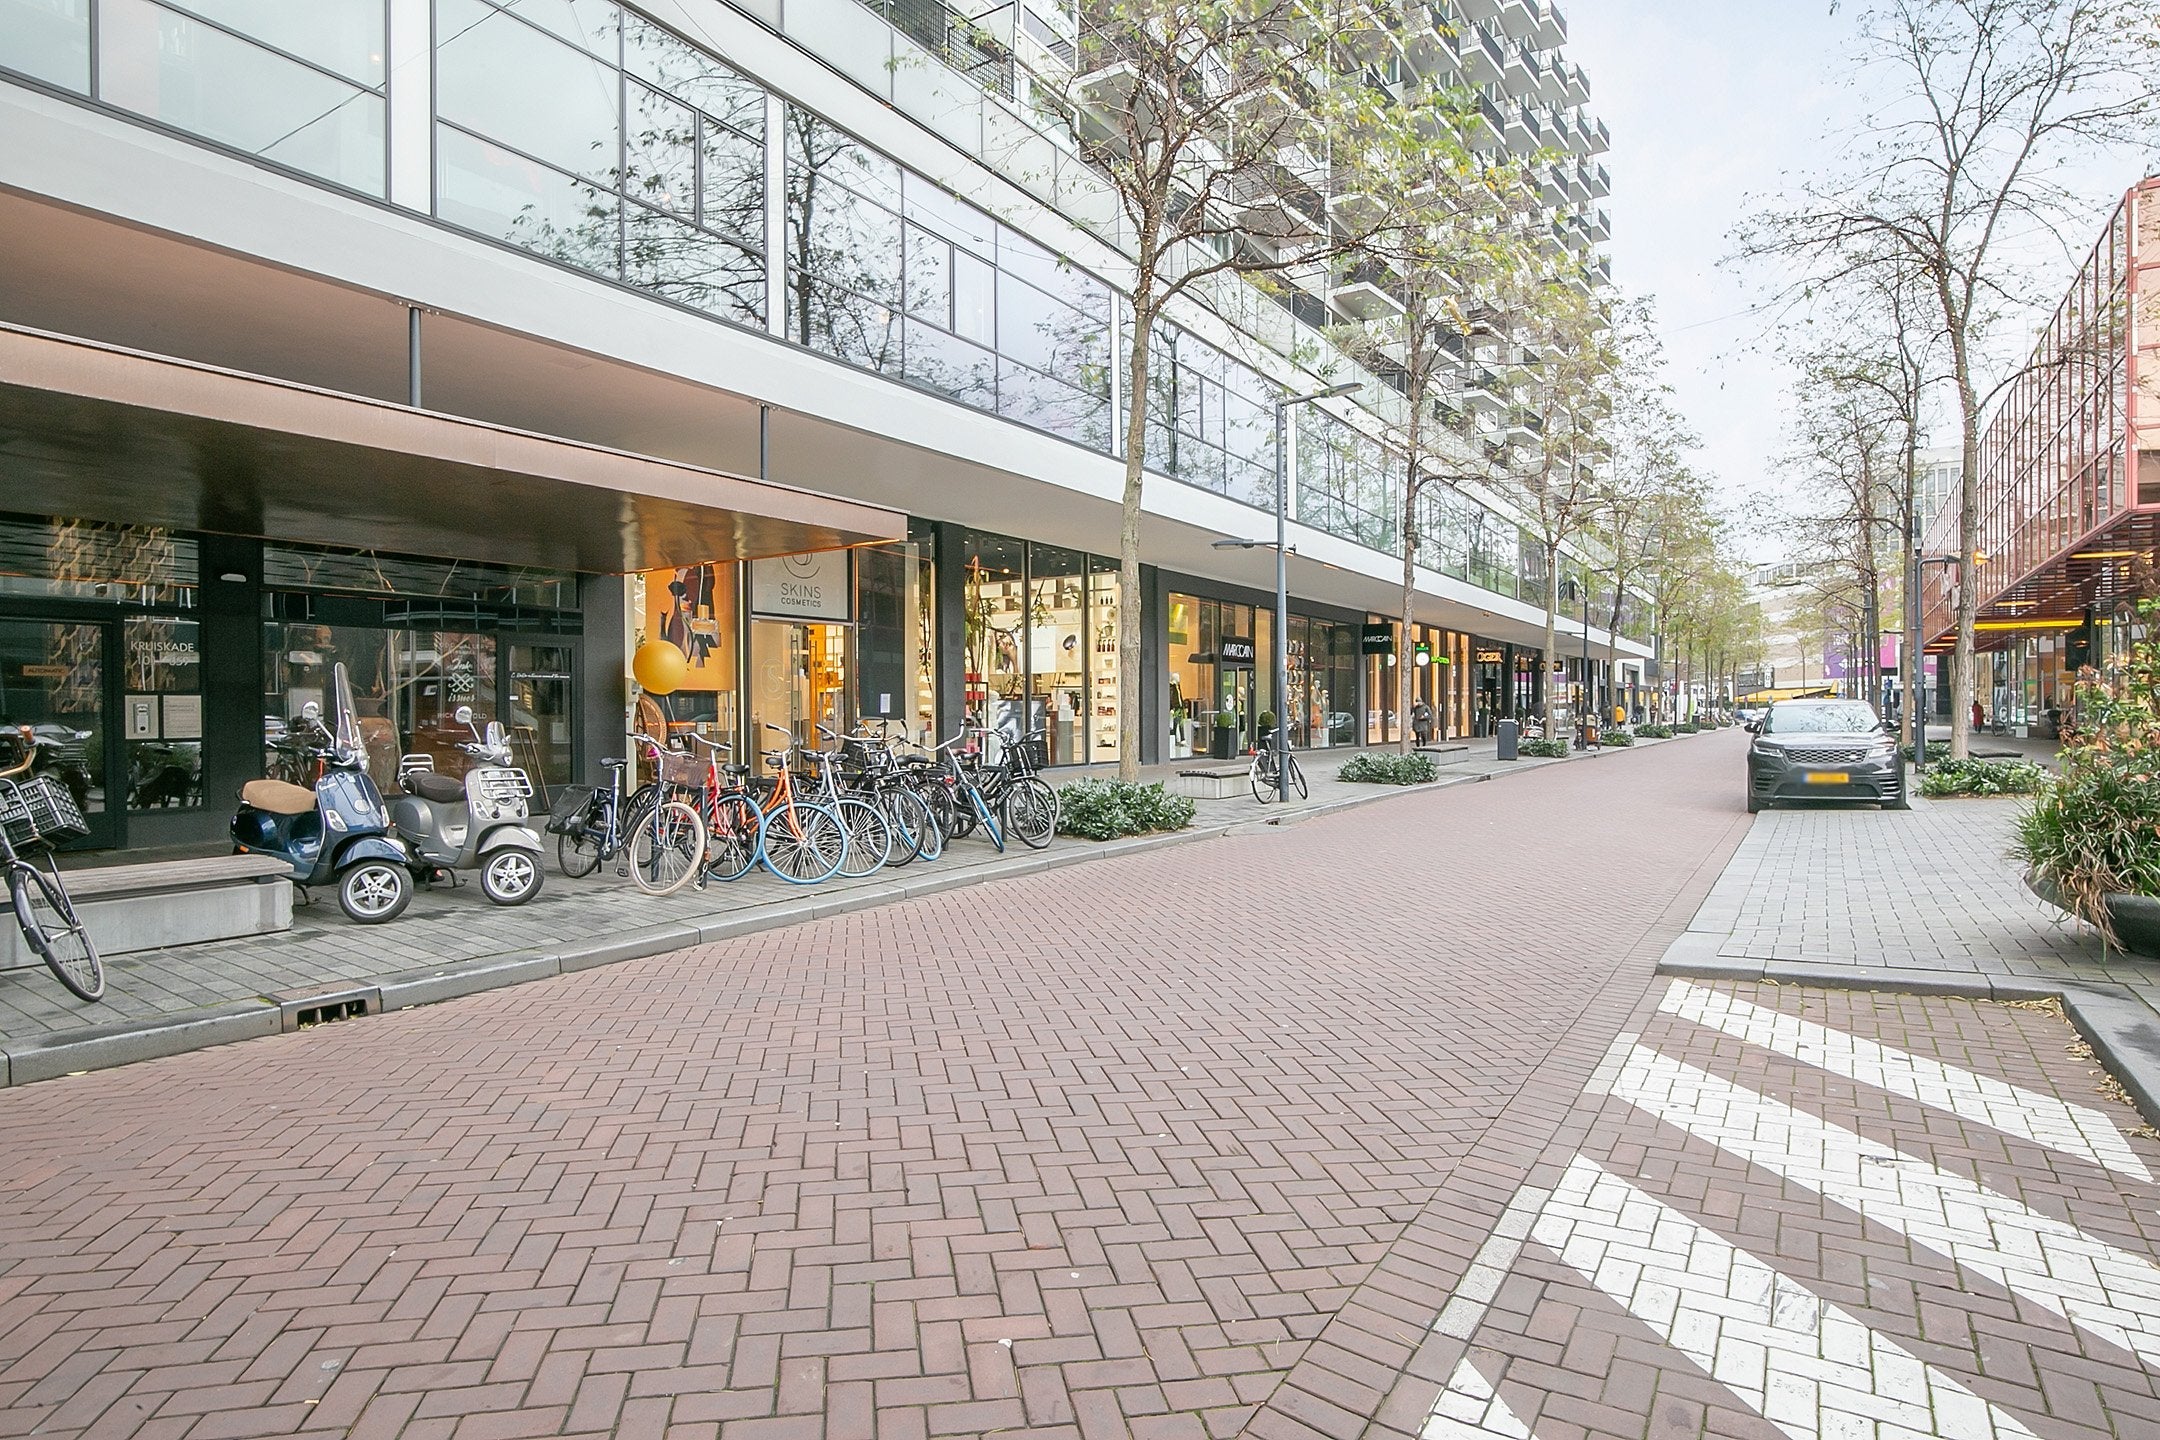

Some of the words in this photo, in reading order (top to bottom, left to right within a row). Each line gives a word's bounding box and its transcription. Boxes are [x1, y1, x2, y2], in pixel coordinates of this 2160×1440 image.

[780, 582, 822, 599] SKINS
[780, 597, 822, 608] COSMETICS
[130, 641, 195, 652] KRUISKADE
